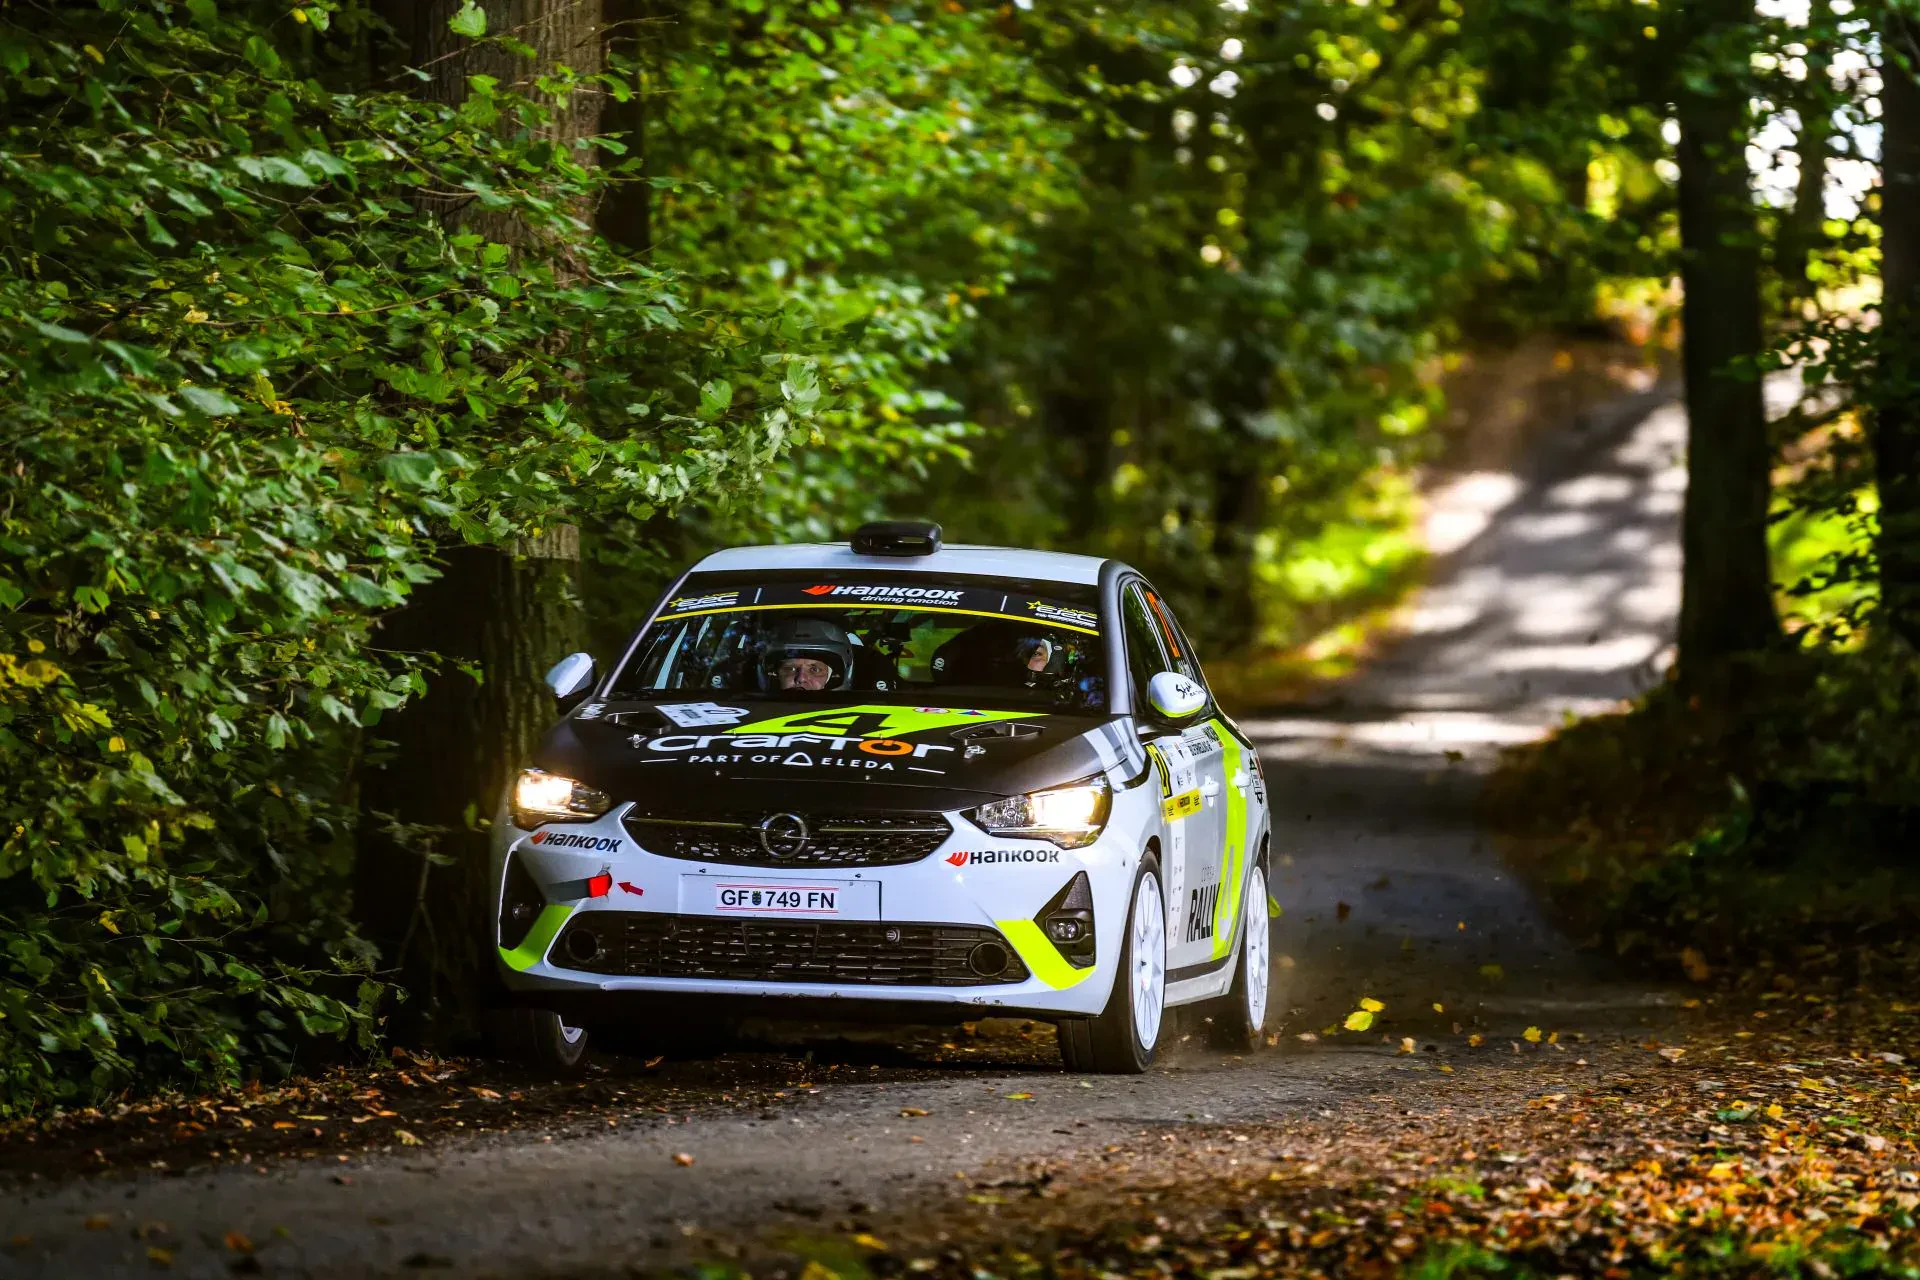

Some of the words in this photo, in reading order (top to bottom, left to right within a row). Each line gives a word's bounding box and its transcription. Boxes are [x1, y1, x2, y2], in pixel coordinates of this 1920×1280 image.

[860, 595, 904, 605] driving
[905, 598, 959, 606] emotion
[688, 754, 746, 764] PART
[750, 754, 782, 763] OF
[821, 757, 895, 771] ELEDA
[720, 889, 749, 906] GF
[765, 890, 801, 908] 749
[807, 892, 835, 909] FN
[1186, 882, 1221, 944] RALLY
